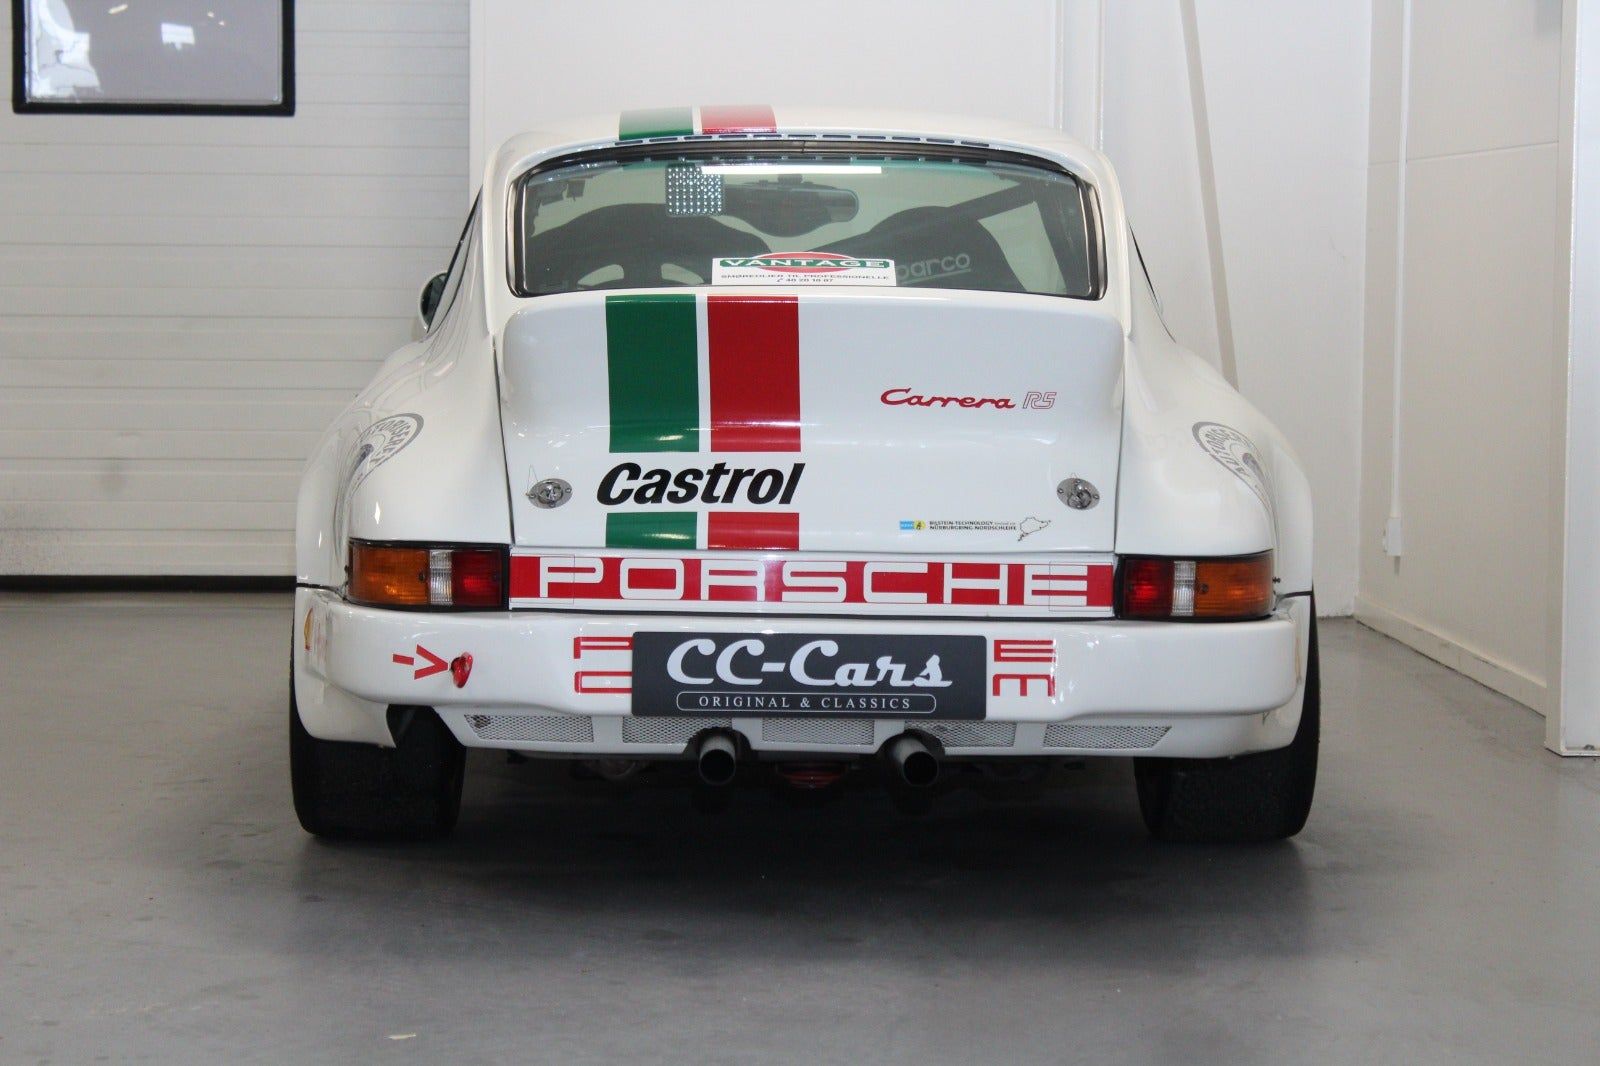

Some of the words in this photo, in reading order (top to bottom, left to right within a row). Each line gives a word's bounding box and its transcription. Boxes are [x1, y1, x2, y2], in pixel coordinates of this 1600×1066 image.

[725, 259, 886, 268] VANTAGE
[895, 253, 971, 281] parco
[880, 387, 1017, 410] Carrera
[1022, 391, 1057, 410] RS
[596, 461, 806, 506] Castrol
[540, 558, 1089, 607] PORSCHE
[666, 638, 953, 689] CC-Cars
[698, 696, 792, 710] ORIGINAL
[799, 696, 812, 710] &
[821, 696, 911, 711] CLASSICS
